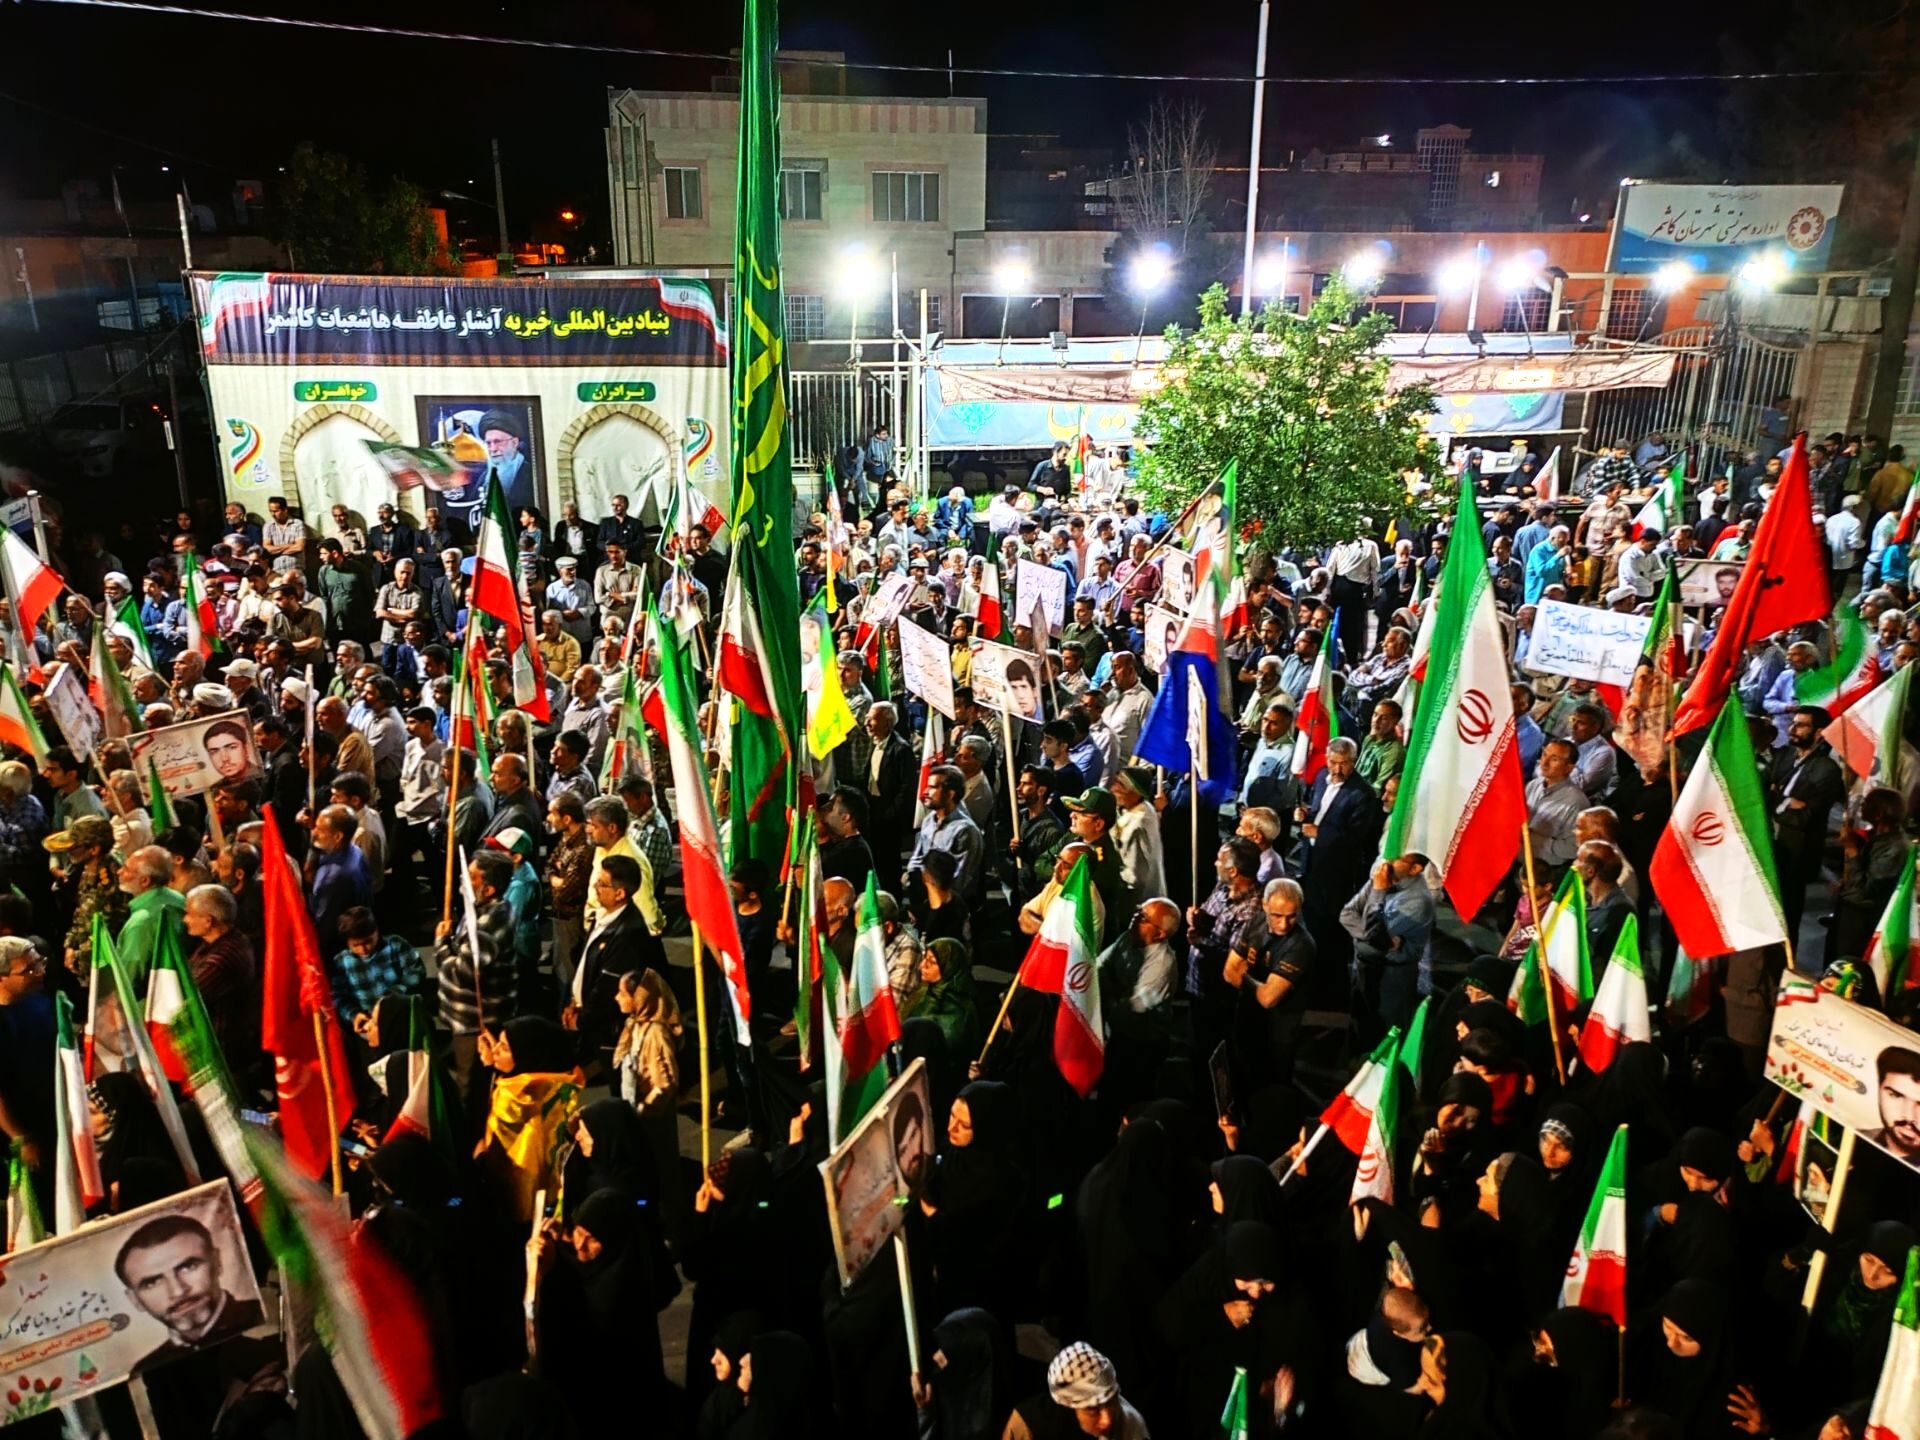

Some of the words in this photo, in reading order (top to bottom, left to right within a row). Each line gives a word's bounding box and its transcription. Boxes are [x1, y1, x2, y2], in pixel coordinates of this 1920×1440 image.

[1648, 205, 1688, 239] کاشمر
[1674, 204, 1720, 243] شهرستان
[265, 306, 316, 334] کاشمر
[317, 307, 371, 333] شعبات
[371, 308, 391, 330] ها
[392, 307, 457, 331] عاطفه
[458, 307, 502, 337] آبشار
[504, 309, 551, 337] خیریه
[553, 309, 606, 337] المللی
[606, 316, 634, 336] بین
[634, 309, 671, 336] بنیاد
[304, 384, 368, 401] خواهران
[592, 384, 646, 401] برادران
[59, 1301, 76, 1319] خدا
[78, 1290, 99, 1324] چشم
[99, 1293, 109, 1312] با
[0, 1306, 22, 1340] کر
[33, 1311, 51, 1337] دنیا
